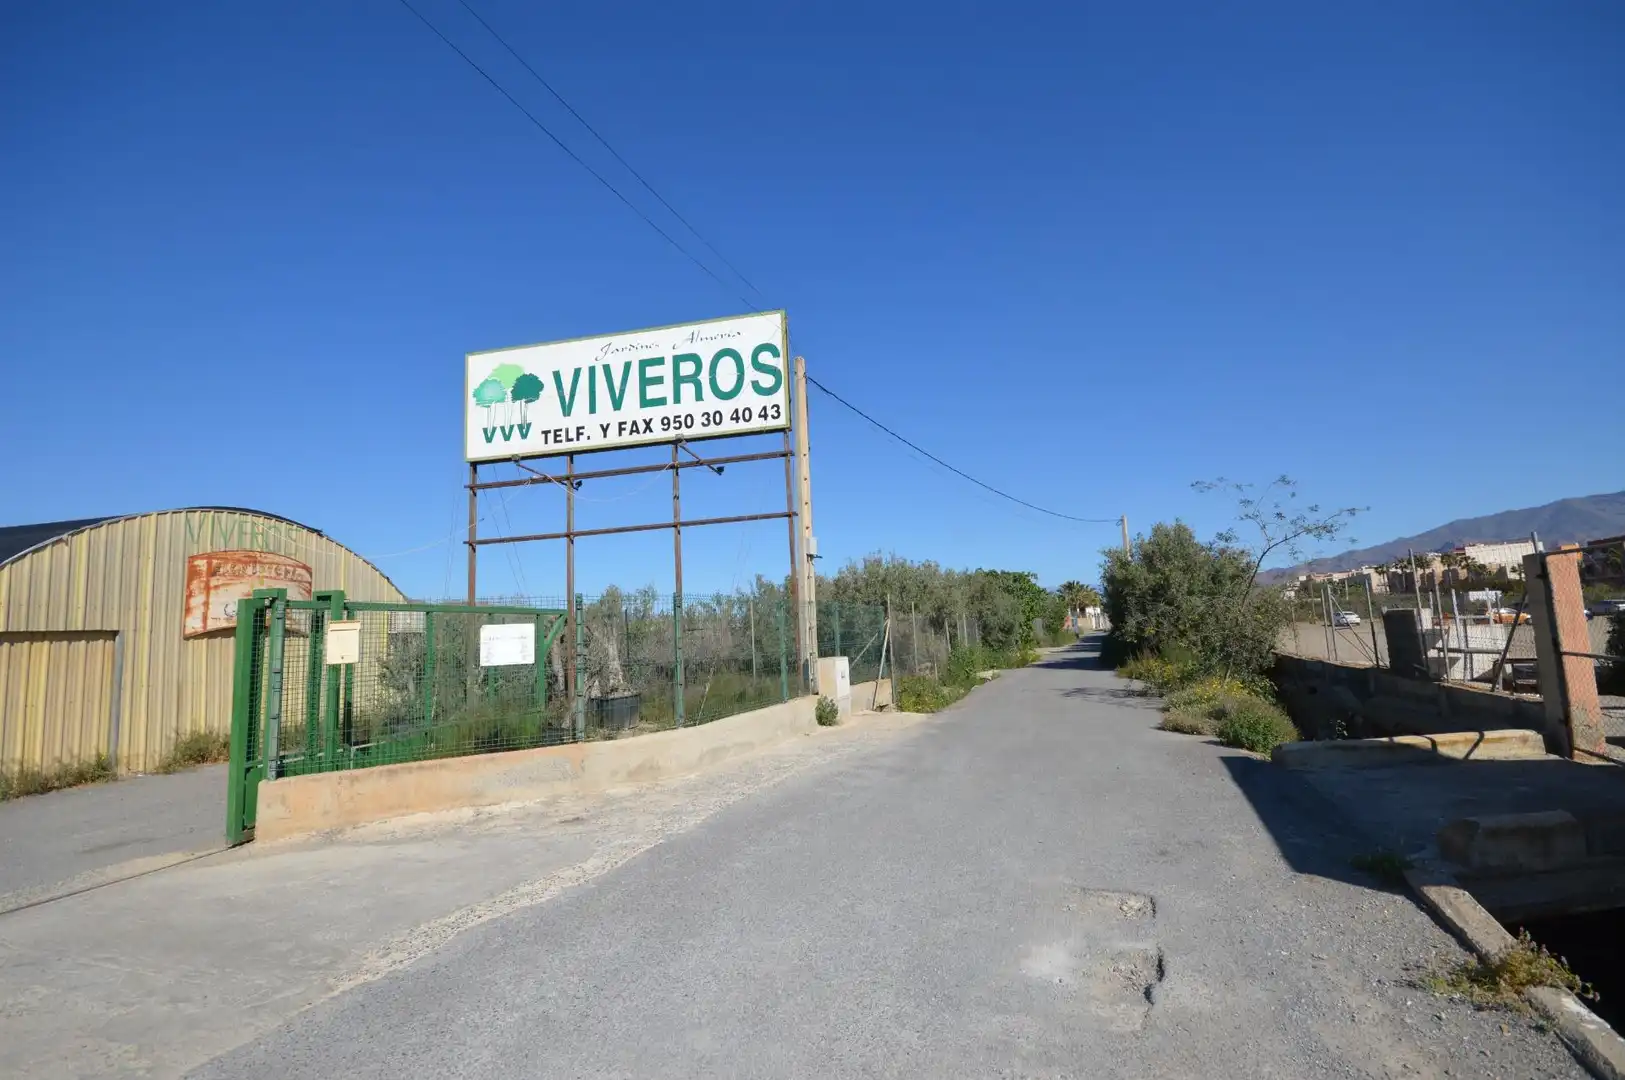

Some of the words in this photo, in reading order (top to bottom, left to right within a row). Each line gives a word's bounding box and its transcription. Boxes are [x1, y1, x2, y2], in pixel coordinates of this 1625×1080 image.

[552, 342, 783, 417] VIVEROS
[541, 425, 591, 445] TELF.
[599, 422, 611, 439] Y
[617, 417, 654, 437] FAX
[660, 413, 694, 432] 950
[701, 411, 723, 428] 30
[730, 406, 752, 424] 40
[758, 403, 782, 421] 43
